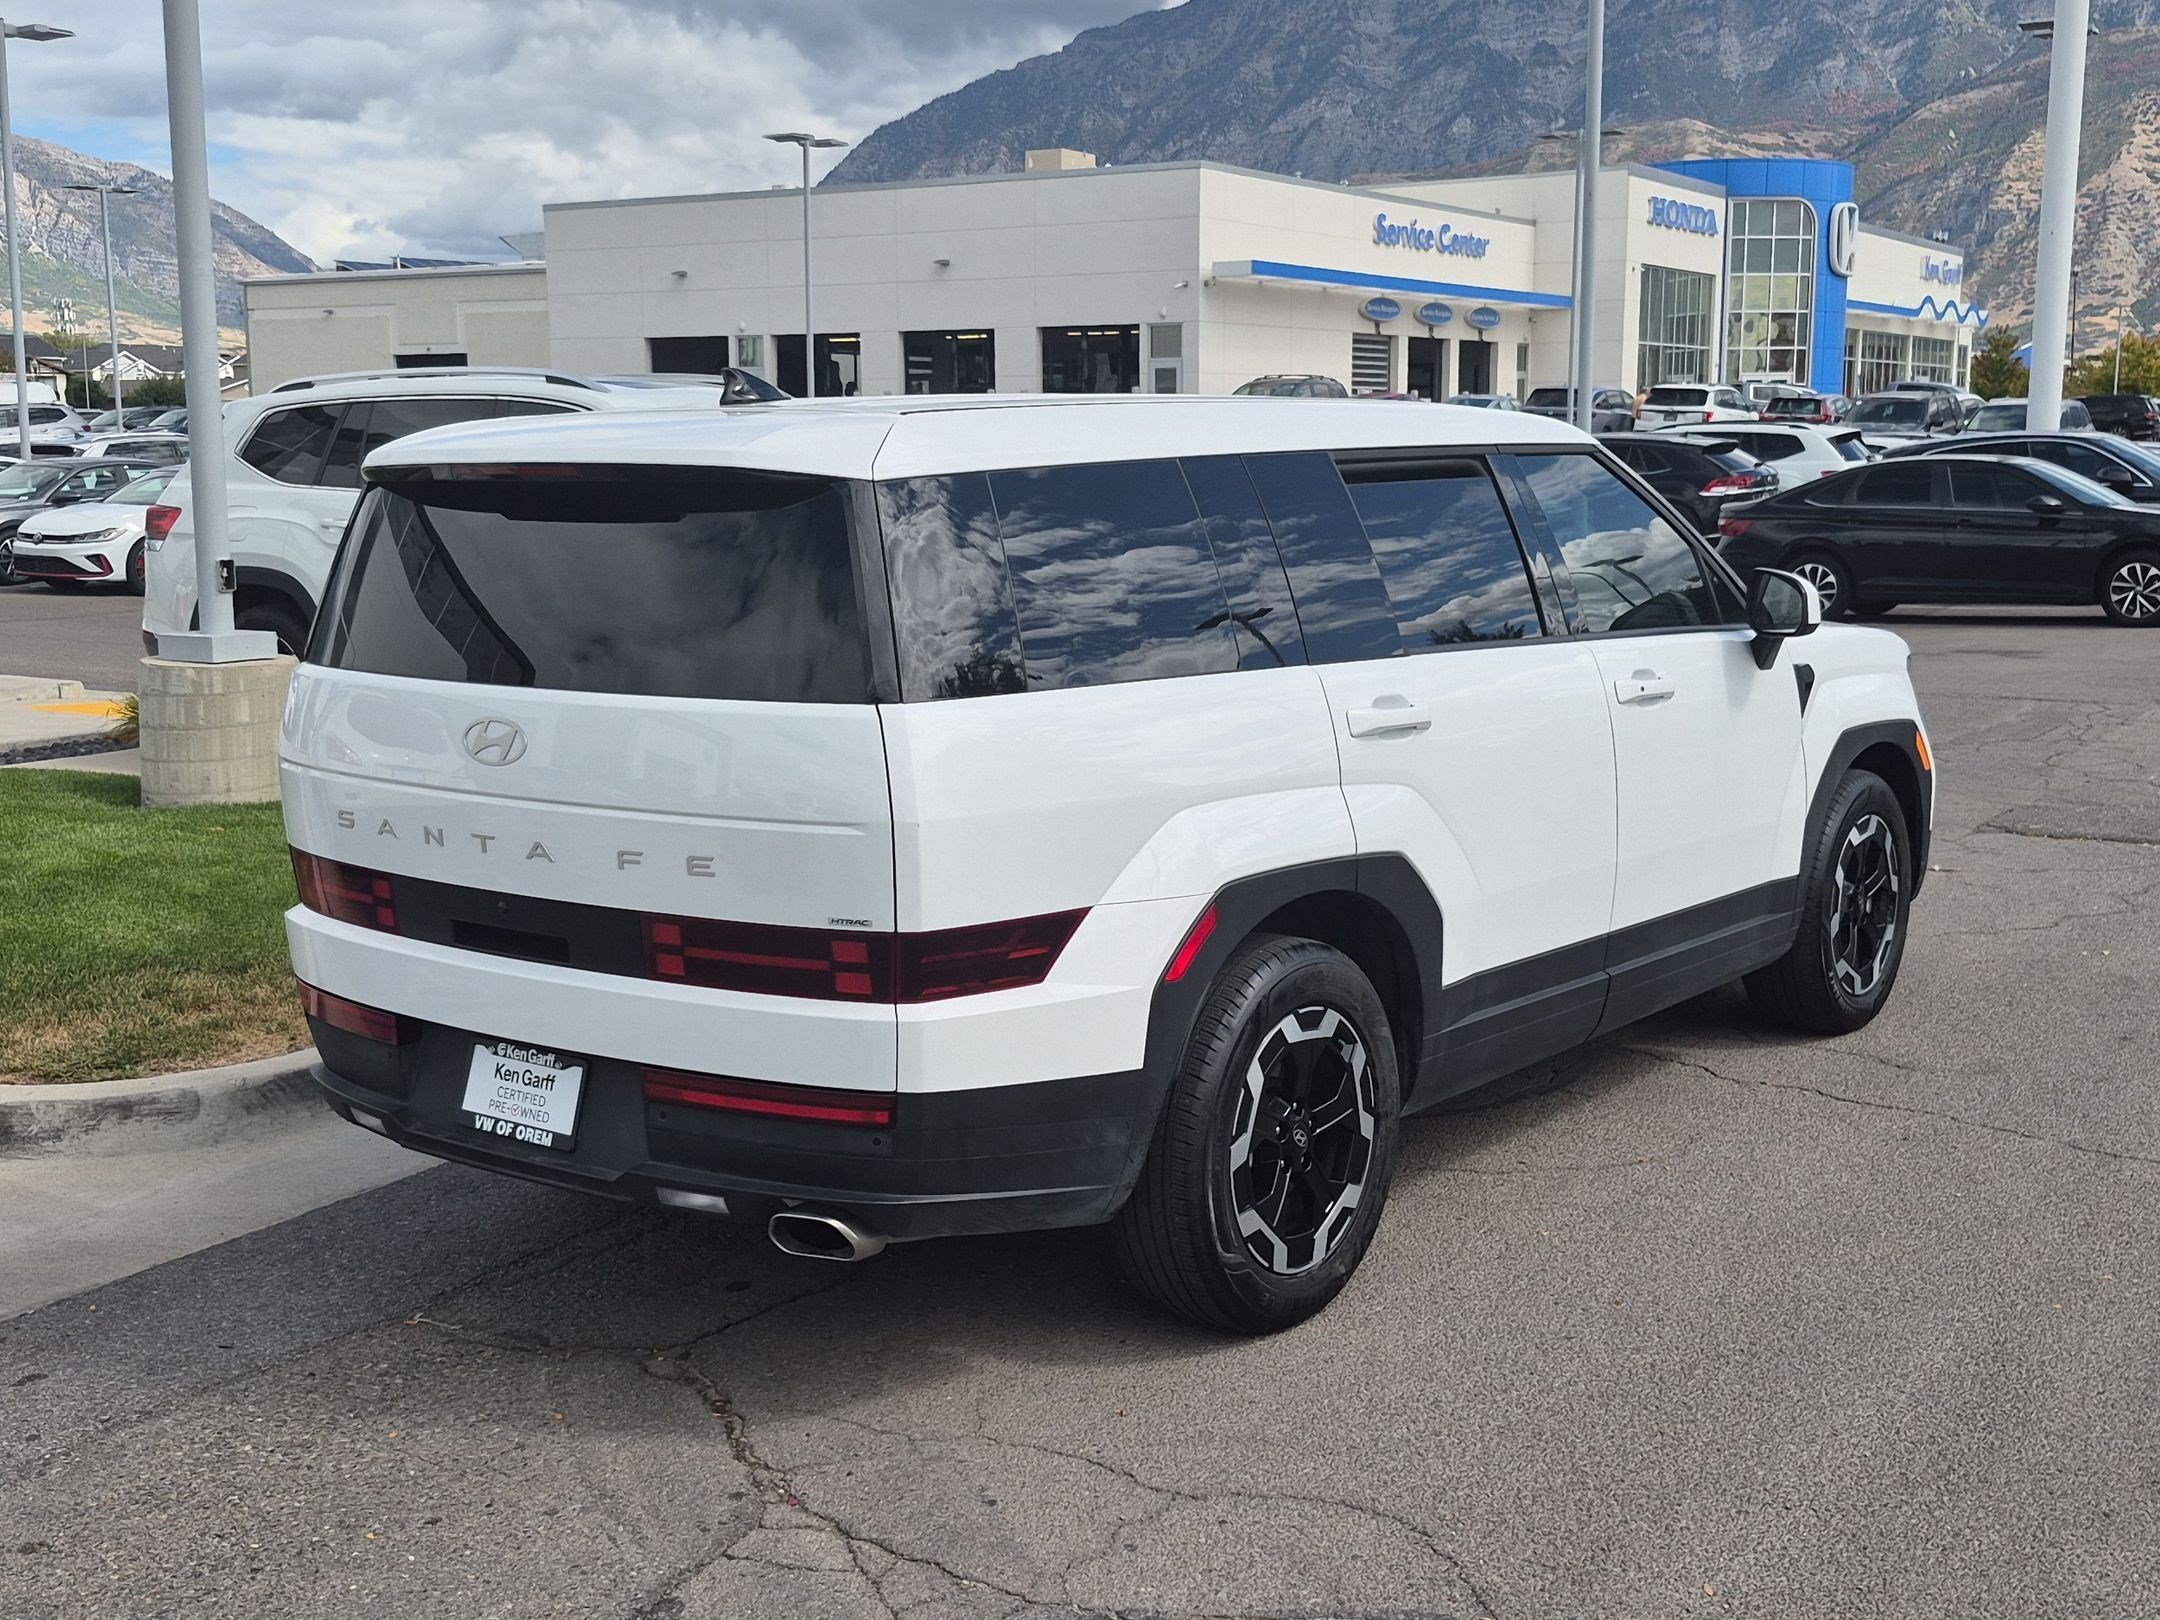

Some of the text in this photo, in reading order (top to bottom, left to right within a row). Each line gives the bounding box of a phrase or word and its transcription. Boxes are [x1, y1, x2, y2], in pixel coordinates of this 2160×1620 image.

[1647, 196, 1718, 237] HONDA
[1373, 213, 1490, 259] Service Center
[337, 809, 717, 878] SANTA FE
[830, 918, 870, 927] HTRAC
[506, 1045, 556, 1068] Ken Garff
[494, 1062, 556, 1091] Ken Garff
[497, 1086, 546, 1107] CERTIFIED
[475, 1115, 553, 1147] VW OF OREM
